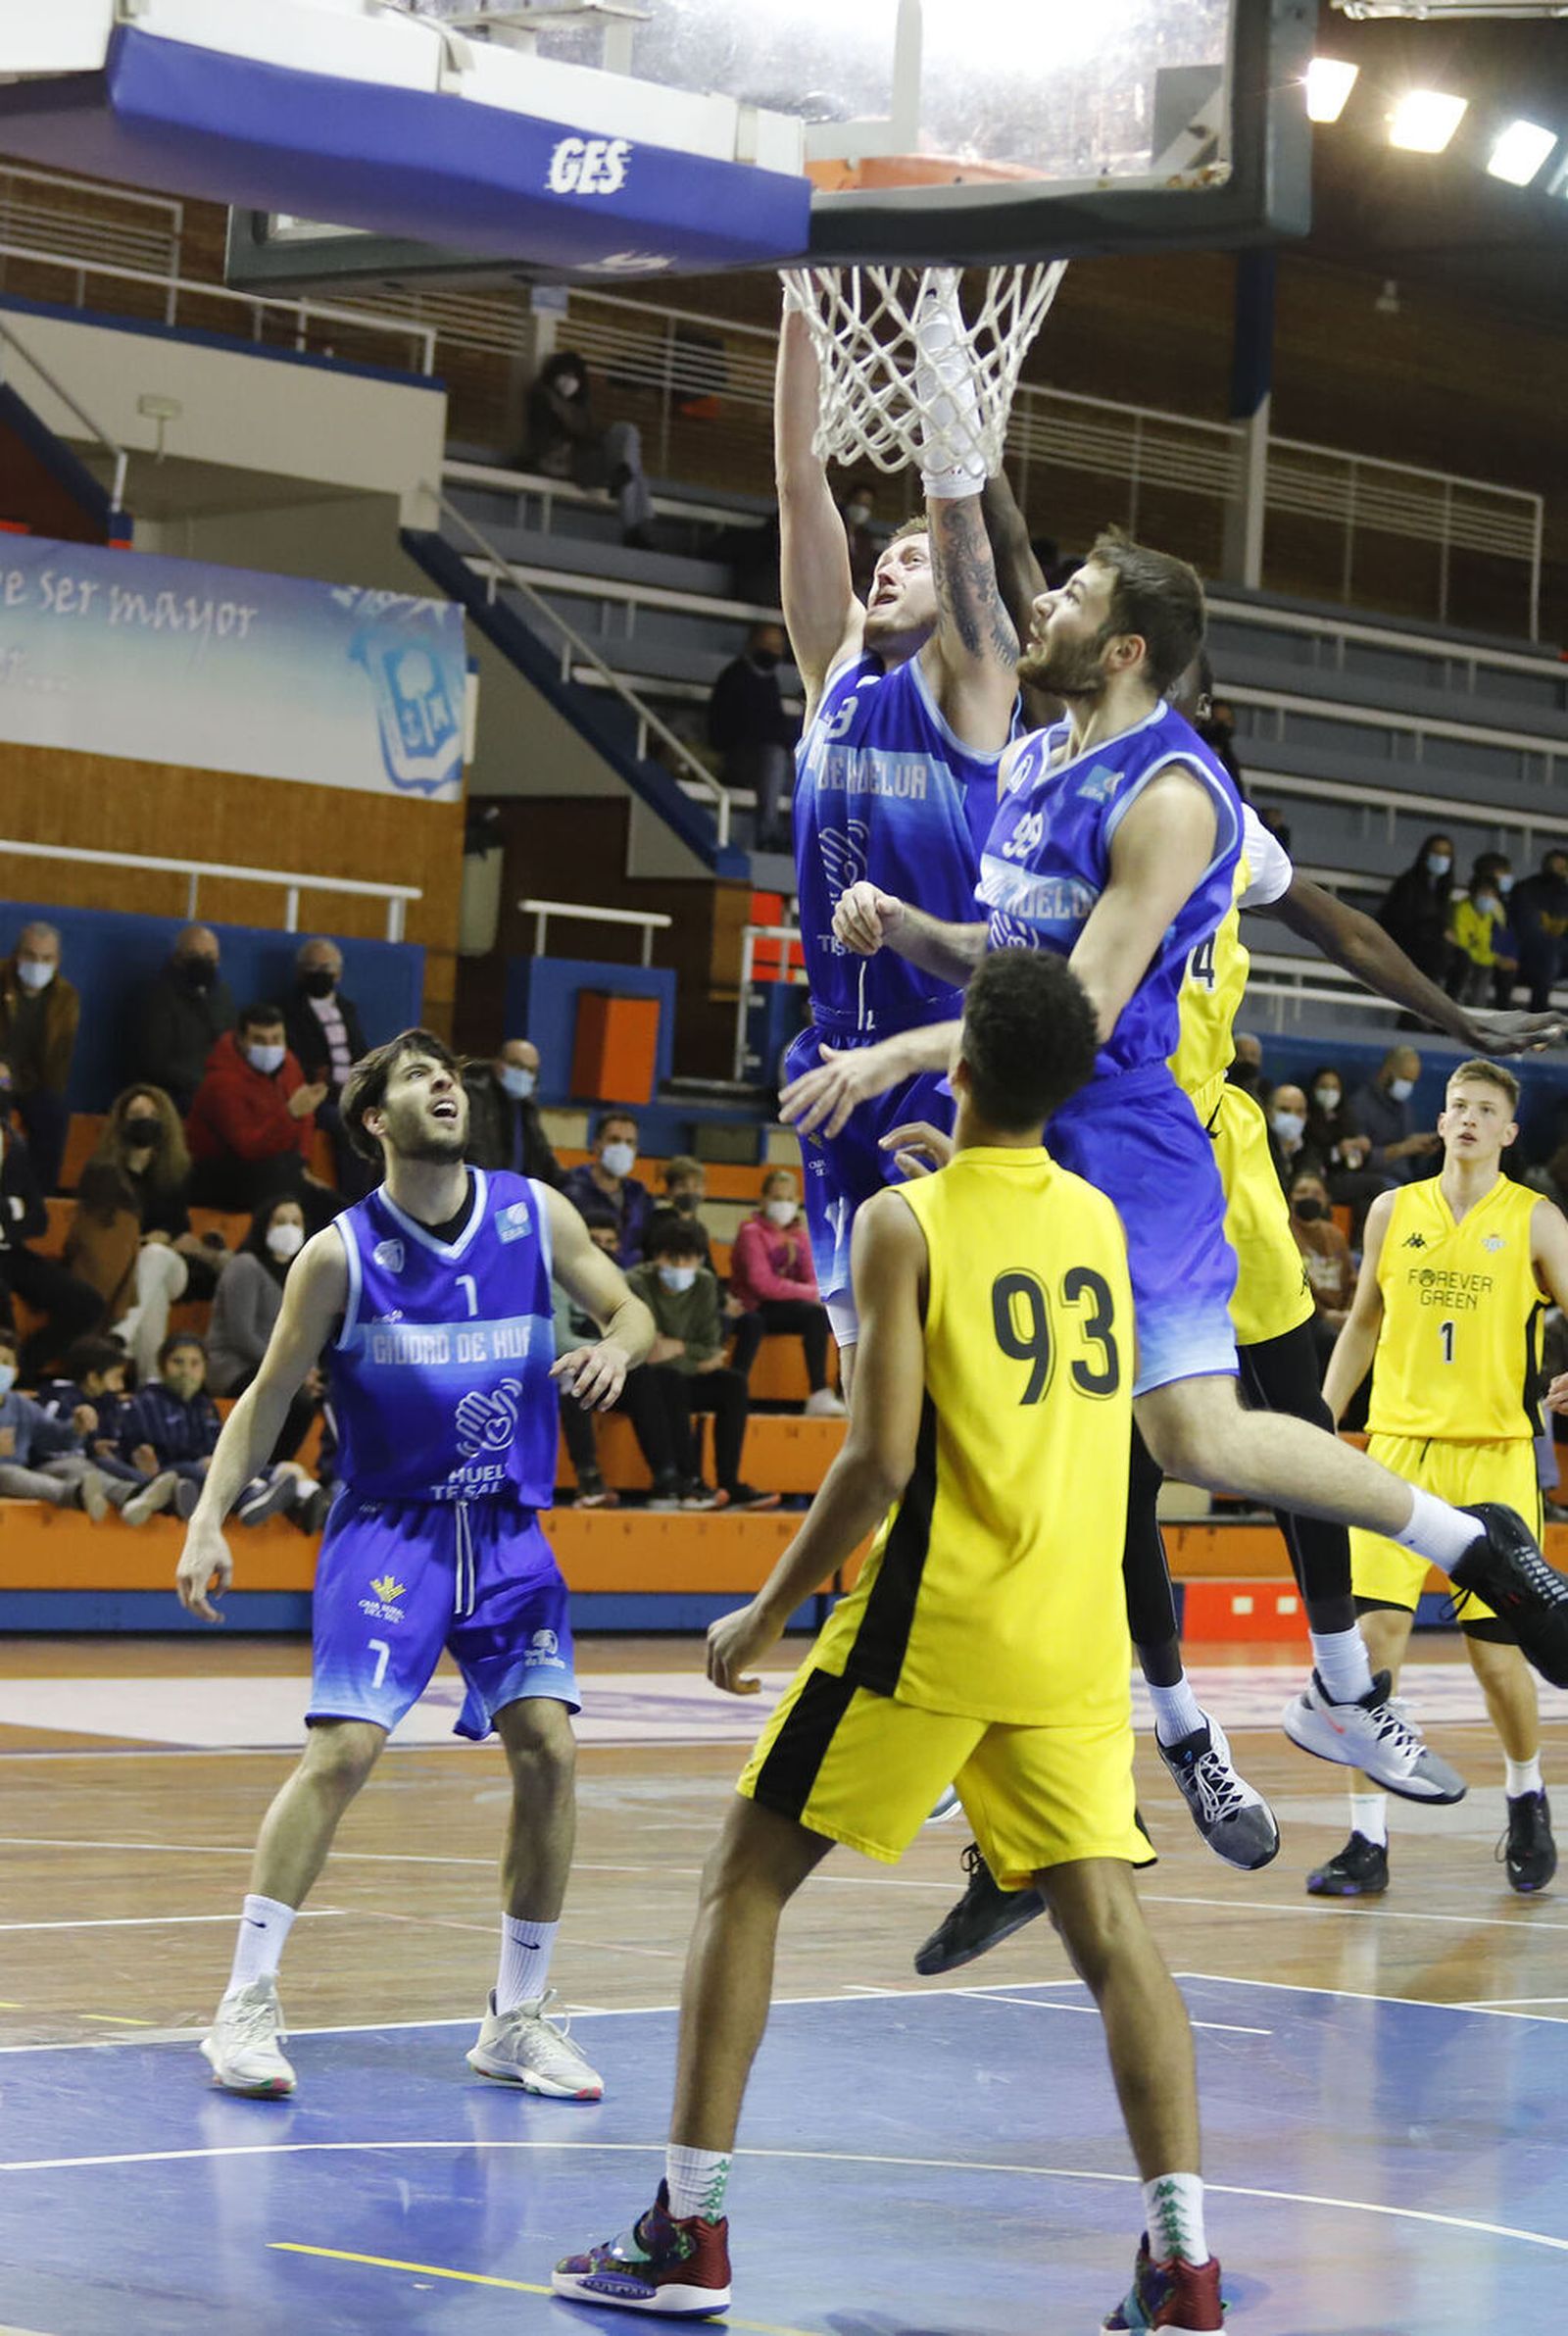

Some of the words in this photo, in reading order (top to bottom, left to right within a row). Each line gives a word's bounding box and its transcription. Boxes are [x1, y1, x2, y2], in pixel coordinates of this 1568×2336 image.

[545, 137, 634, 194] GES
[0, 571, 27, 605] e
[40, 571, 98, 613] ser
[110, 585, 259, 667] mayor
[1191, 929, 1216, 989] 4
[1408, 1267, 1494, 1293] FOREVER
[1420, 1289, 1478, 1312] GREEN
[456, 1331, 487, 1364] DE
[992, 1267, 1120, 1406] 93
[1440, 1321, 1454, 1363] 1
